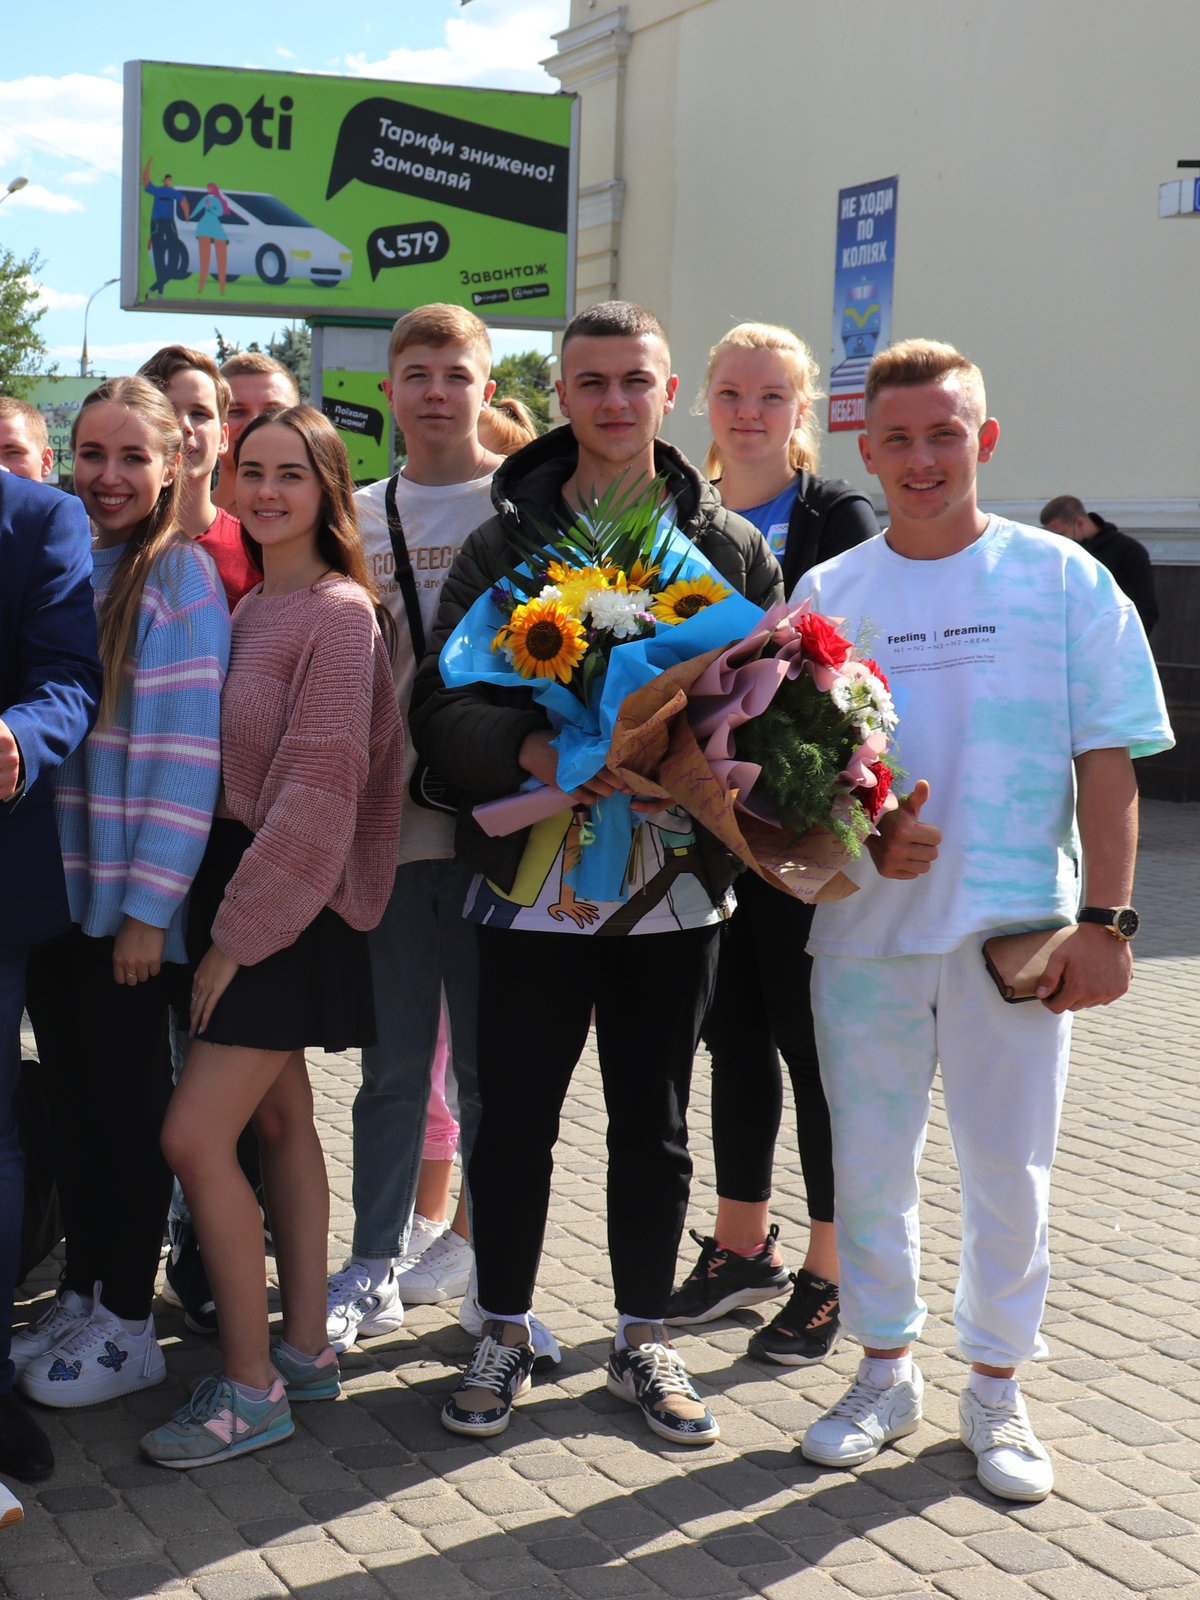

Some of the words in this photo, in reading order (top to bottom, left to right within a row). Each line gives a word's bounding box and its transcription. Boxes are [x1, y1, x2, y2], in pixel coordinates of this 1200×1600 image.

[162, 94, 294, 157] opti
[378, 116, 455, 157] Тарифи
[459, 143, 556, 184] знижено!
[370, 147, 471, 192] Замовляй
[841, 196, 857, 220] НЕ
[859, 187, 894, 216] ХОДИ
[857, 218, 874, 241] ПО
[397, 230, 439, 257] 579
[842, 240, 887, 269] КОЛІЯХ
[459, 263, 548, 285] Завантаж
[335, 405, 369, 421] Поїхали
[341, 417, 366, 429] нами!
[888, 633, 926, 644] Feeling
[943, 624, 996, 638] dreaming
